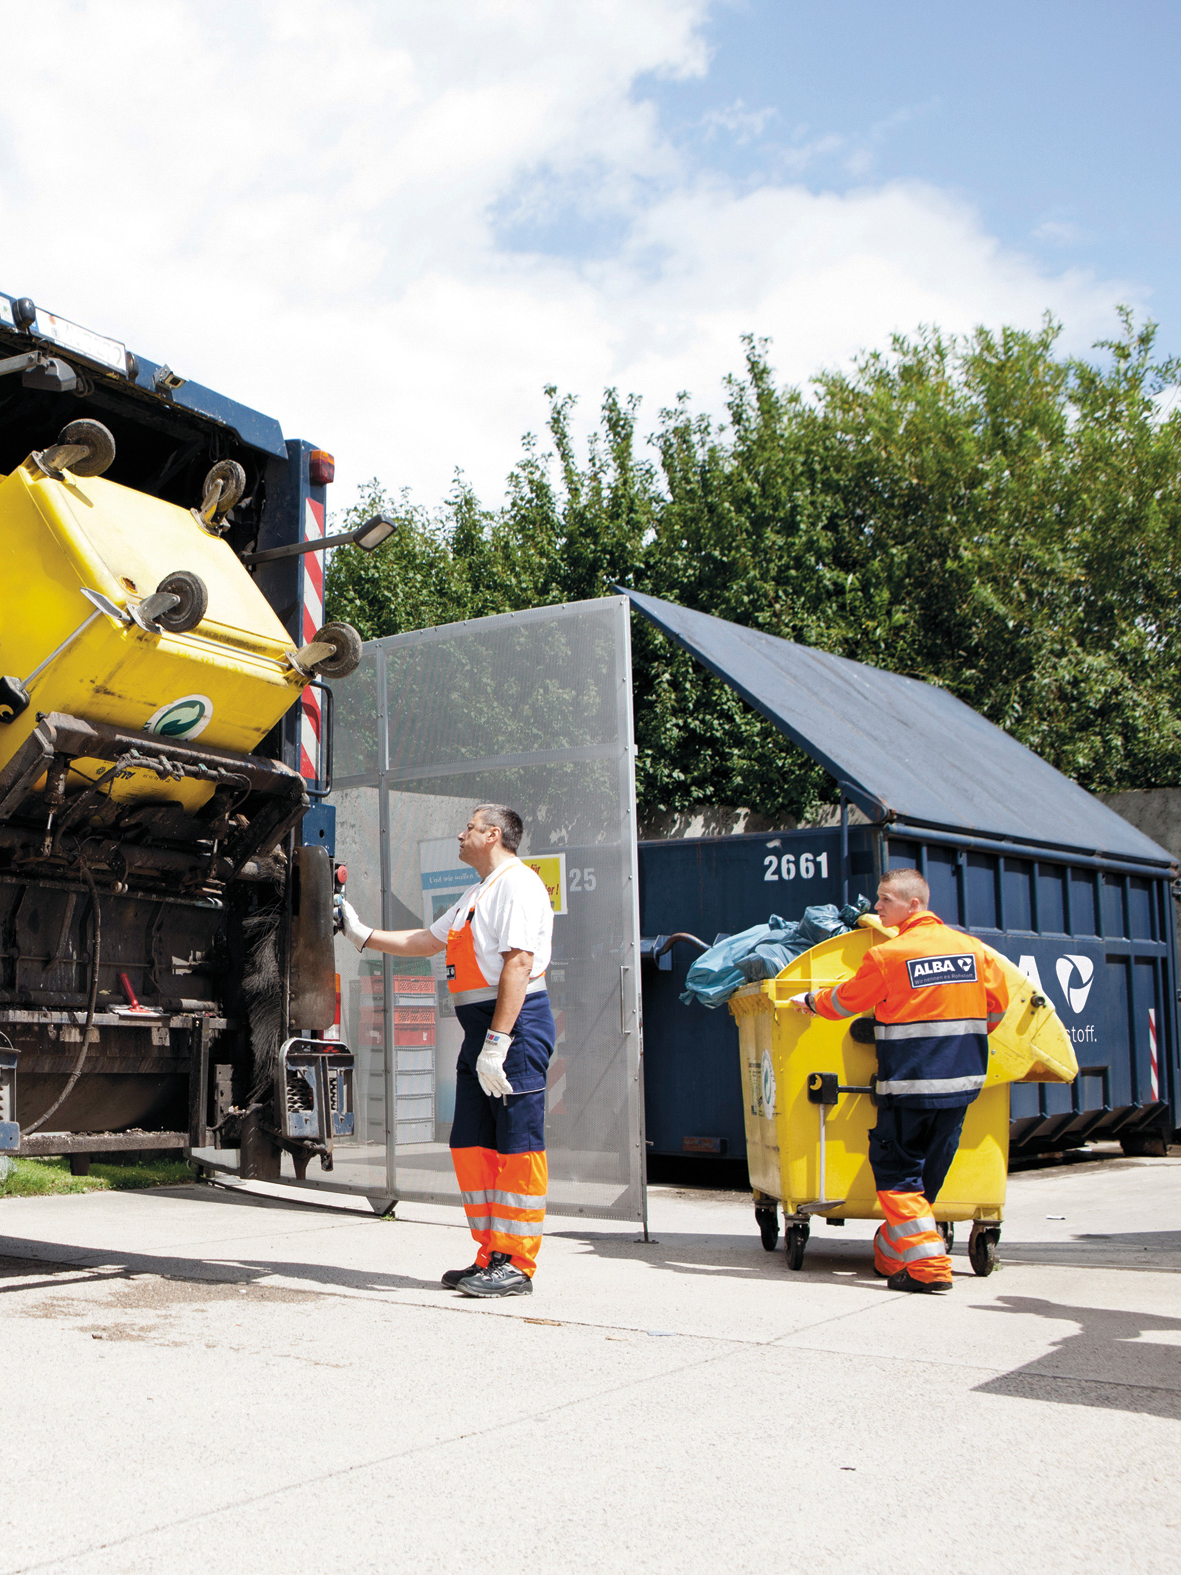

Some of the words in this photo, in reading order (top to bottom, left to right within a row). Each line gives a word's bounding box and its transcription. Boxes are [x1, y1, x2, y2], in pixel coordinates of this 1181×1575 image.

[763, 852, 828, 881] 2661
[569, 867, 597, 892] 25
[914, 960, 956, 977] ALBA
